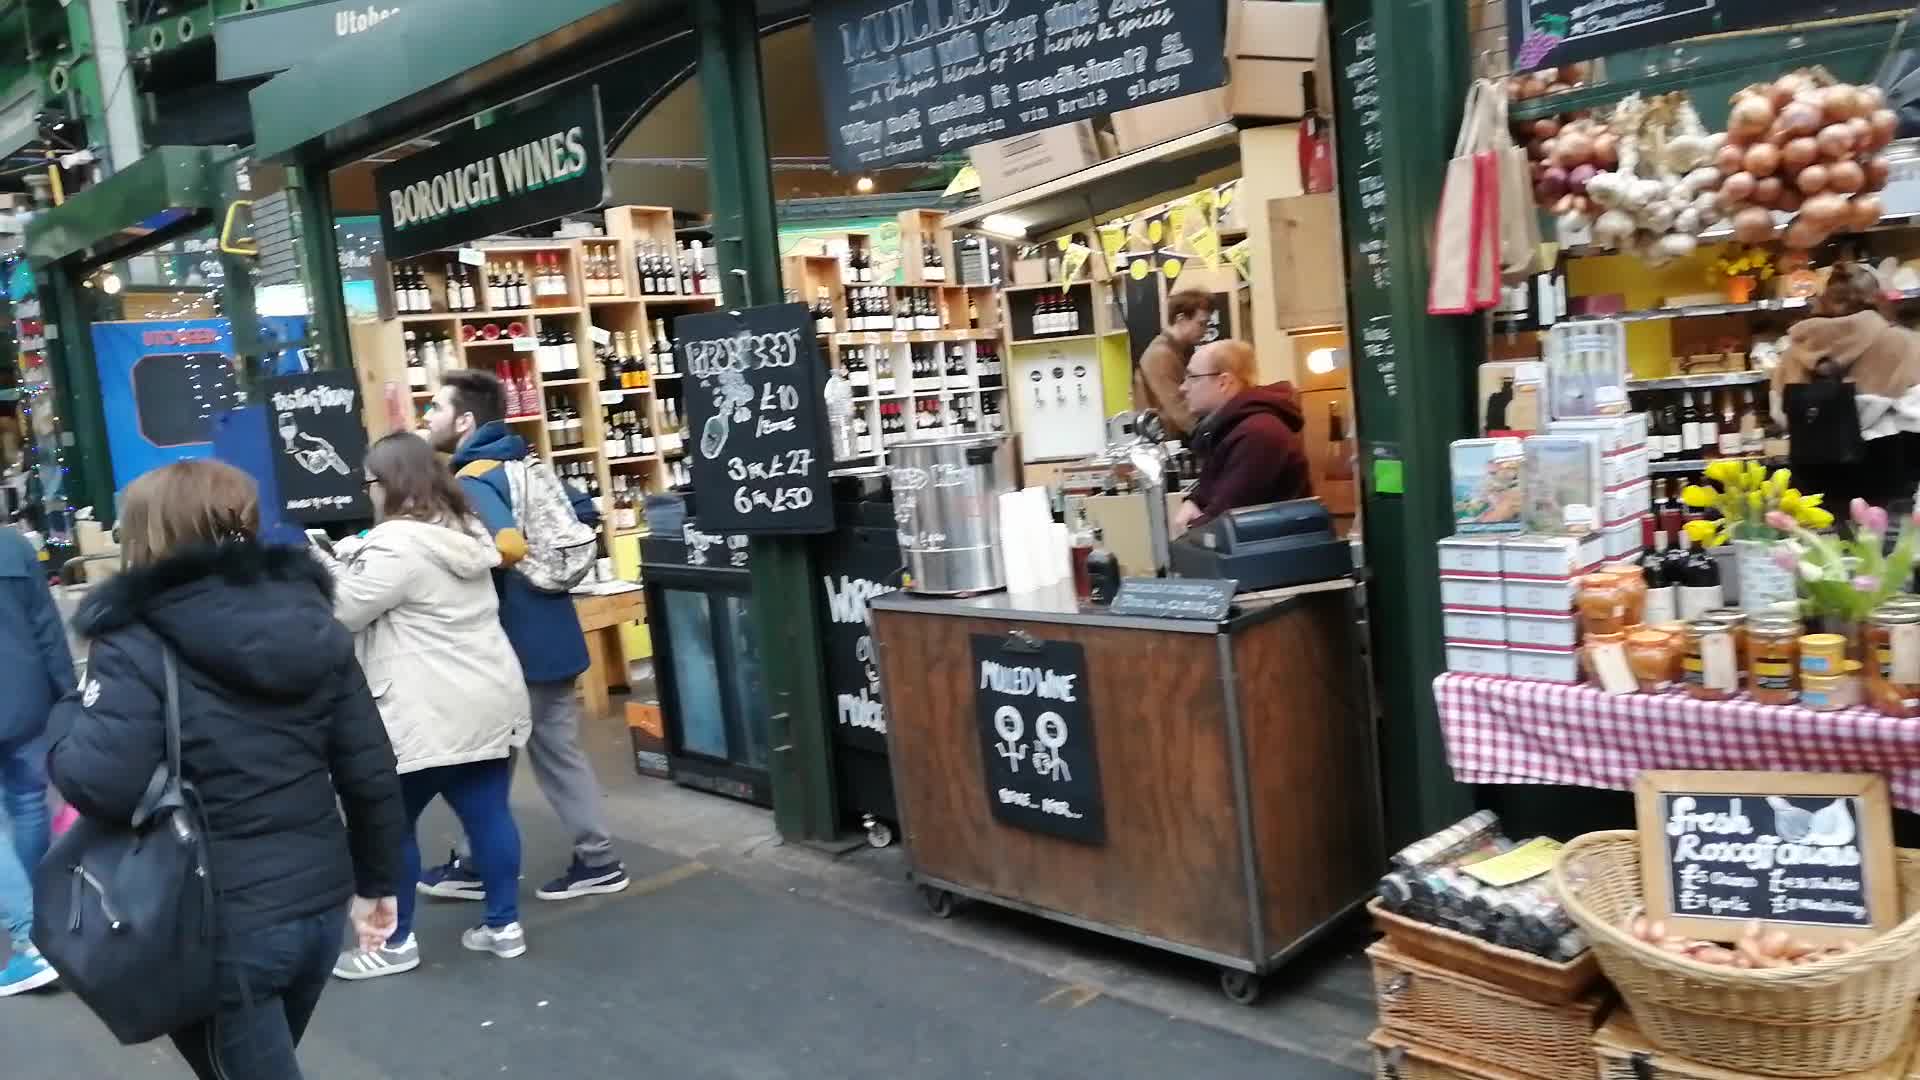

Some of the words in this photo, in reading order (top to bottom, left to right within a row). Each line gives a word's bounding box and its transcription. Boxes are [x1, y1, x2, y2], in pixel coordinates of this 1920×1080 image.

[928, 93, 986, 125] make
[1017, 45, 1149, 102] medicinal?
[389, 156, 500, 230] BOROUGH
[498, 125, 588, 194] WINES
[727, 457, 748, 481] 3
[734, 486, 753, 513] 6
[1666, 796, 1755, 836] Fresh
